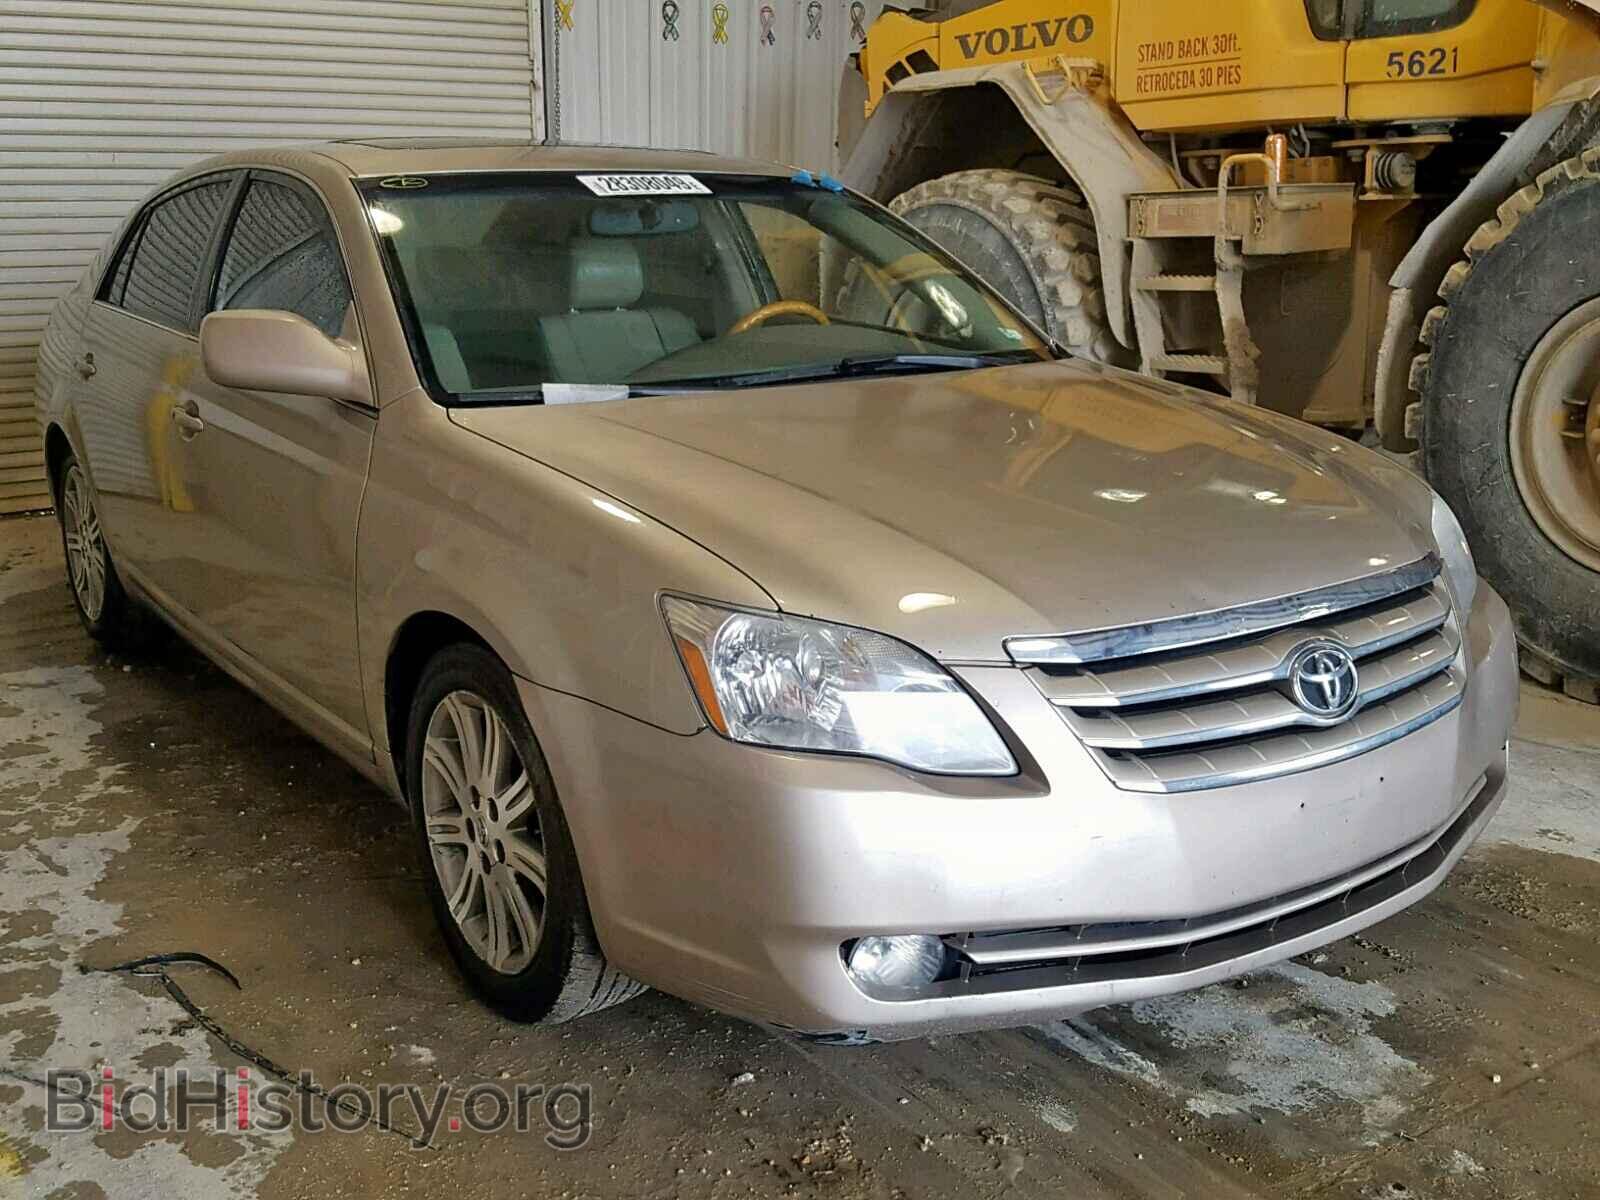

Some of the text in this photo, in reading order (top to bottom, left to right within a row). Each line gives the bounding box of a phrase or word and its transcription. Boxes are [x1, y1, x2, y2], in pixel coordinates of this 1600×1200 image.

[954, 14, 1094, 59] VOLVO
[1137, 41, 1174, 63] STAND
[1178, 36, 1209, 59] BACK
[1386, 46, 1458, 78] 5621
[1136, 64, 1241, 94] RETROCEDA 30 PIES
